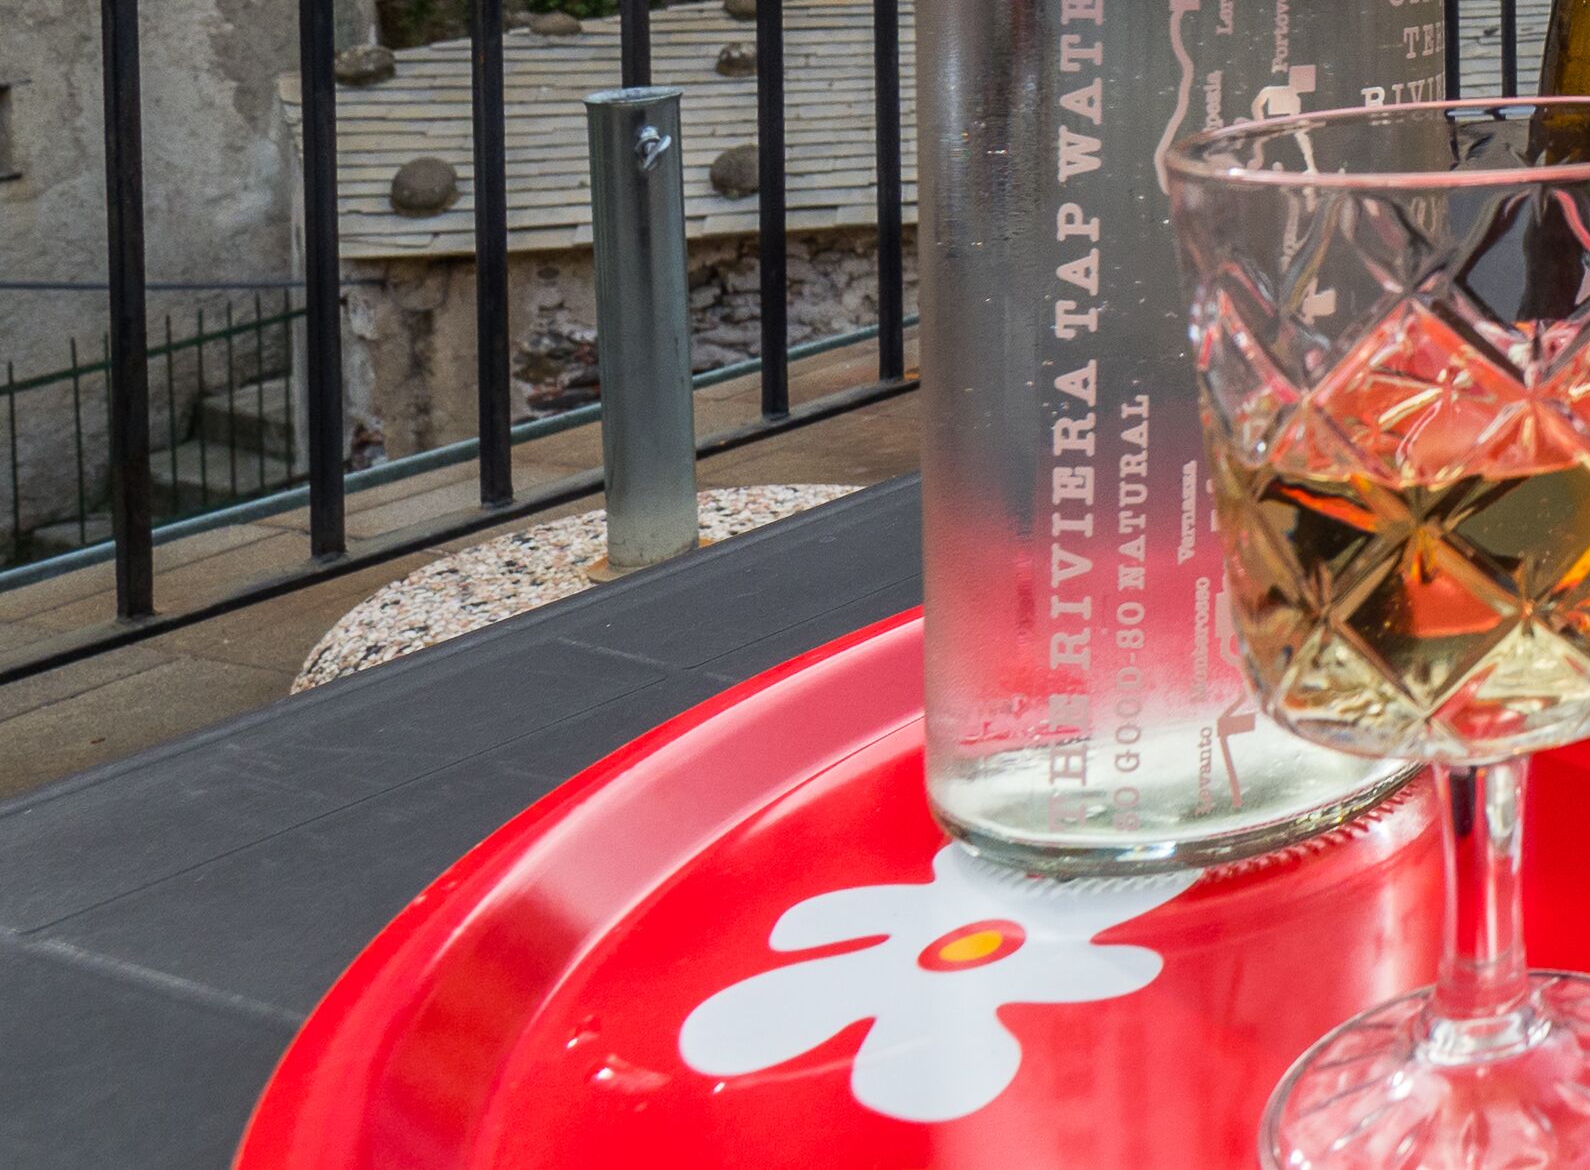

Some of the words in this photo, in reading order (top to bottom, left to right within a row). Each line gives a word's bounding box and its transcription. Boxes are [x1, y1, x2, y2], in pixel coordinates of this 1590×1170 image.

[1204, 70, 1224, 131] pezia
[1055, 202, 1101, 341] TAP
[1050, 359, 1098, 670] RIVIERA
[1118, 395, 1150, 591] NATURAL
[1049, 694, 1090, 830] THE
